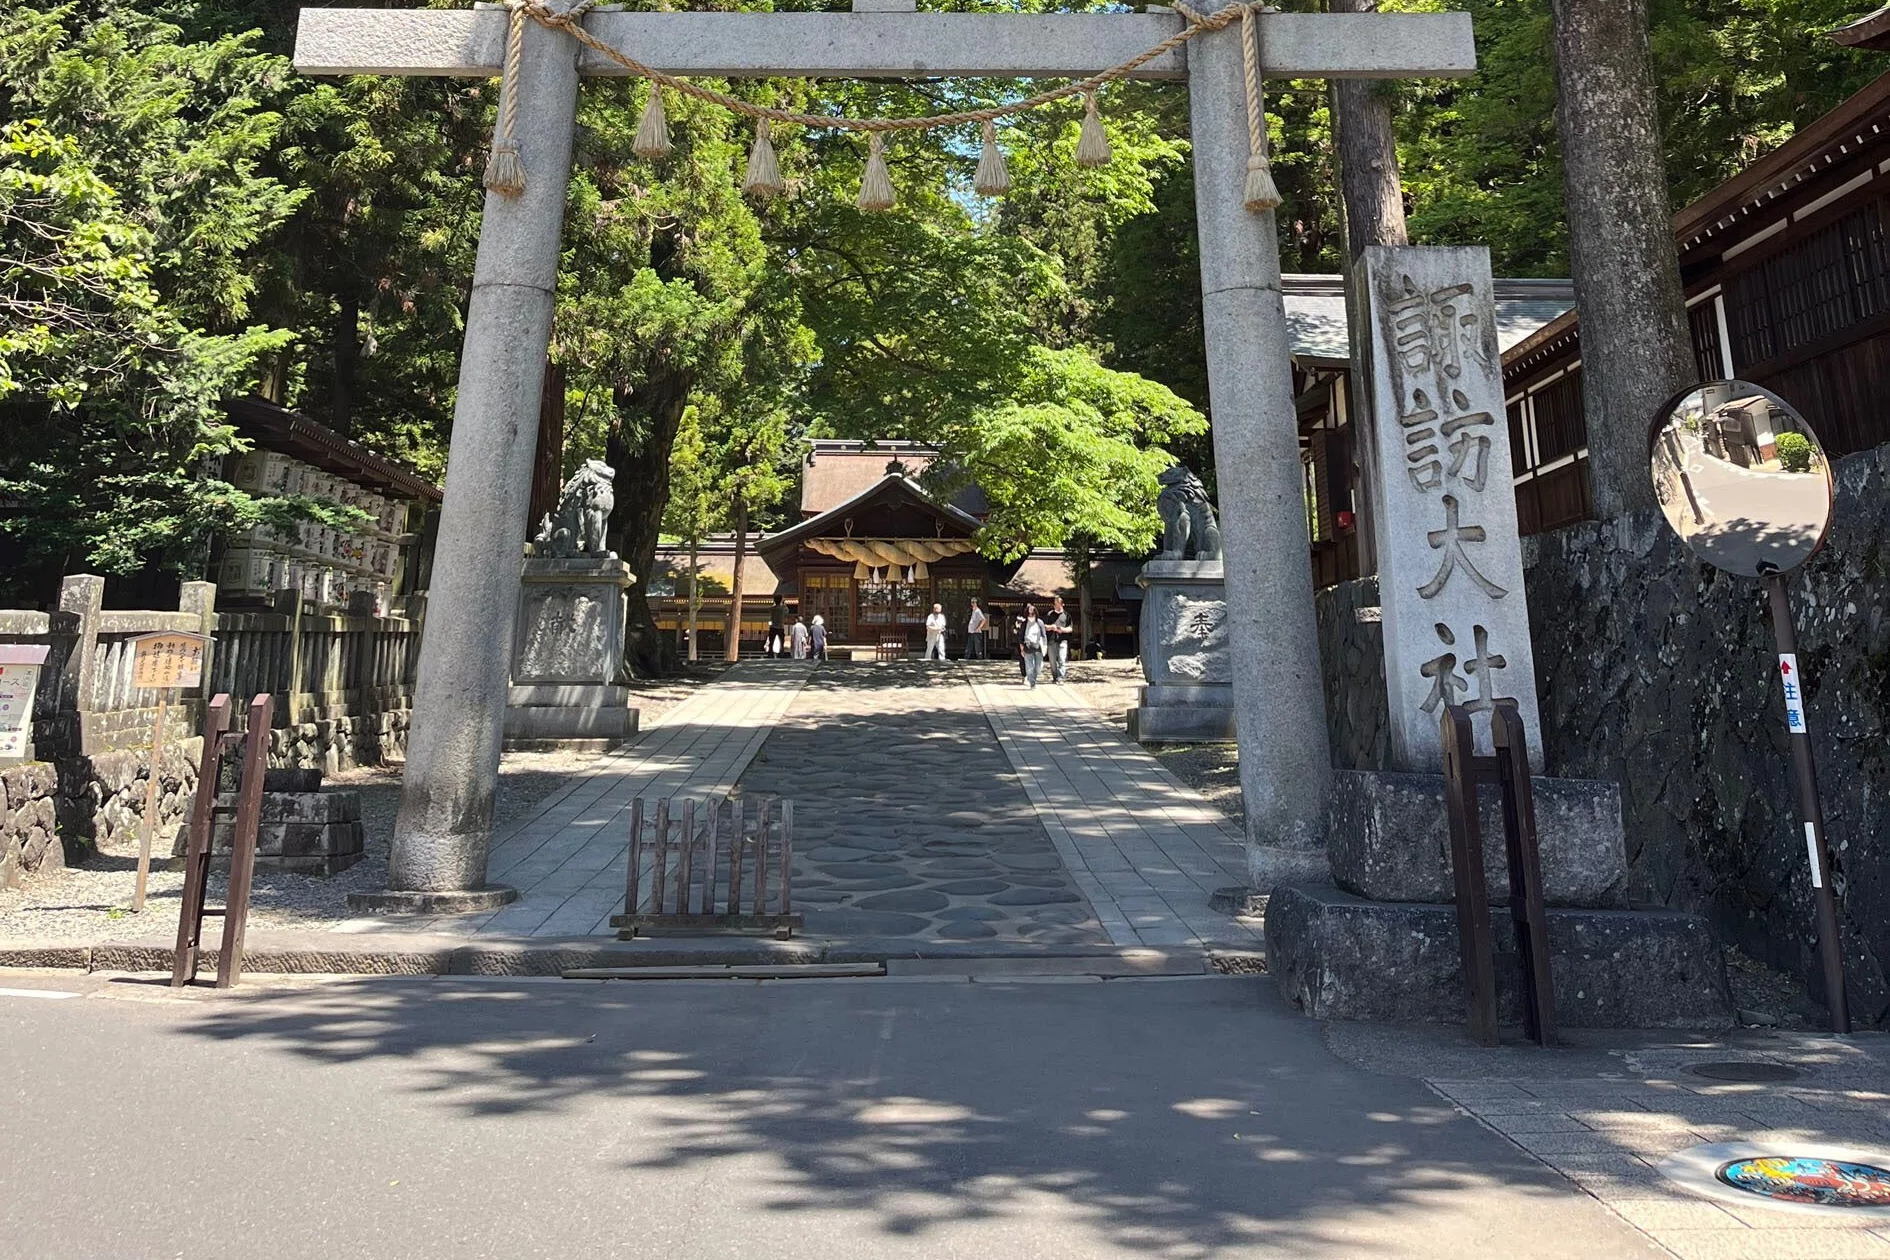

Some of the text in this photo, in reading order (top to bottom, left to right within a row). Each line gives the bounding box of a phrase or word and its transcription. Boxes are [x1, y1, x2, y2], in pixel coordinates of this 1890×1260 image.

[1388, 274, 1519, 714] 諏訪大社
[1190, 612, 1213, 640] 奉
